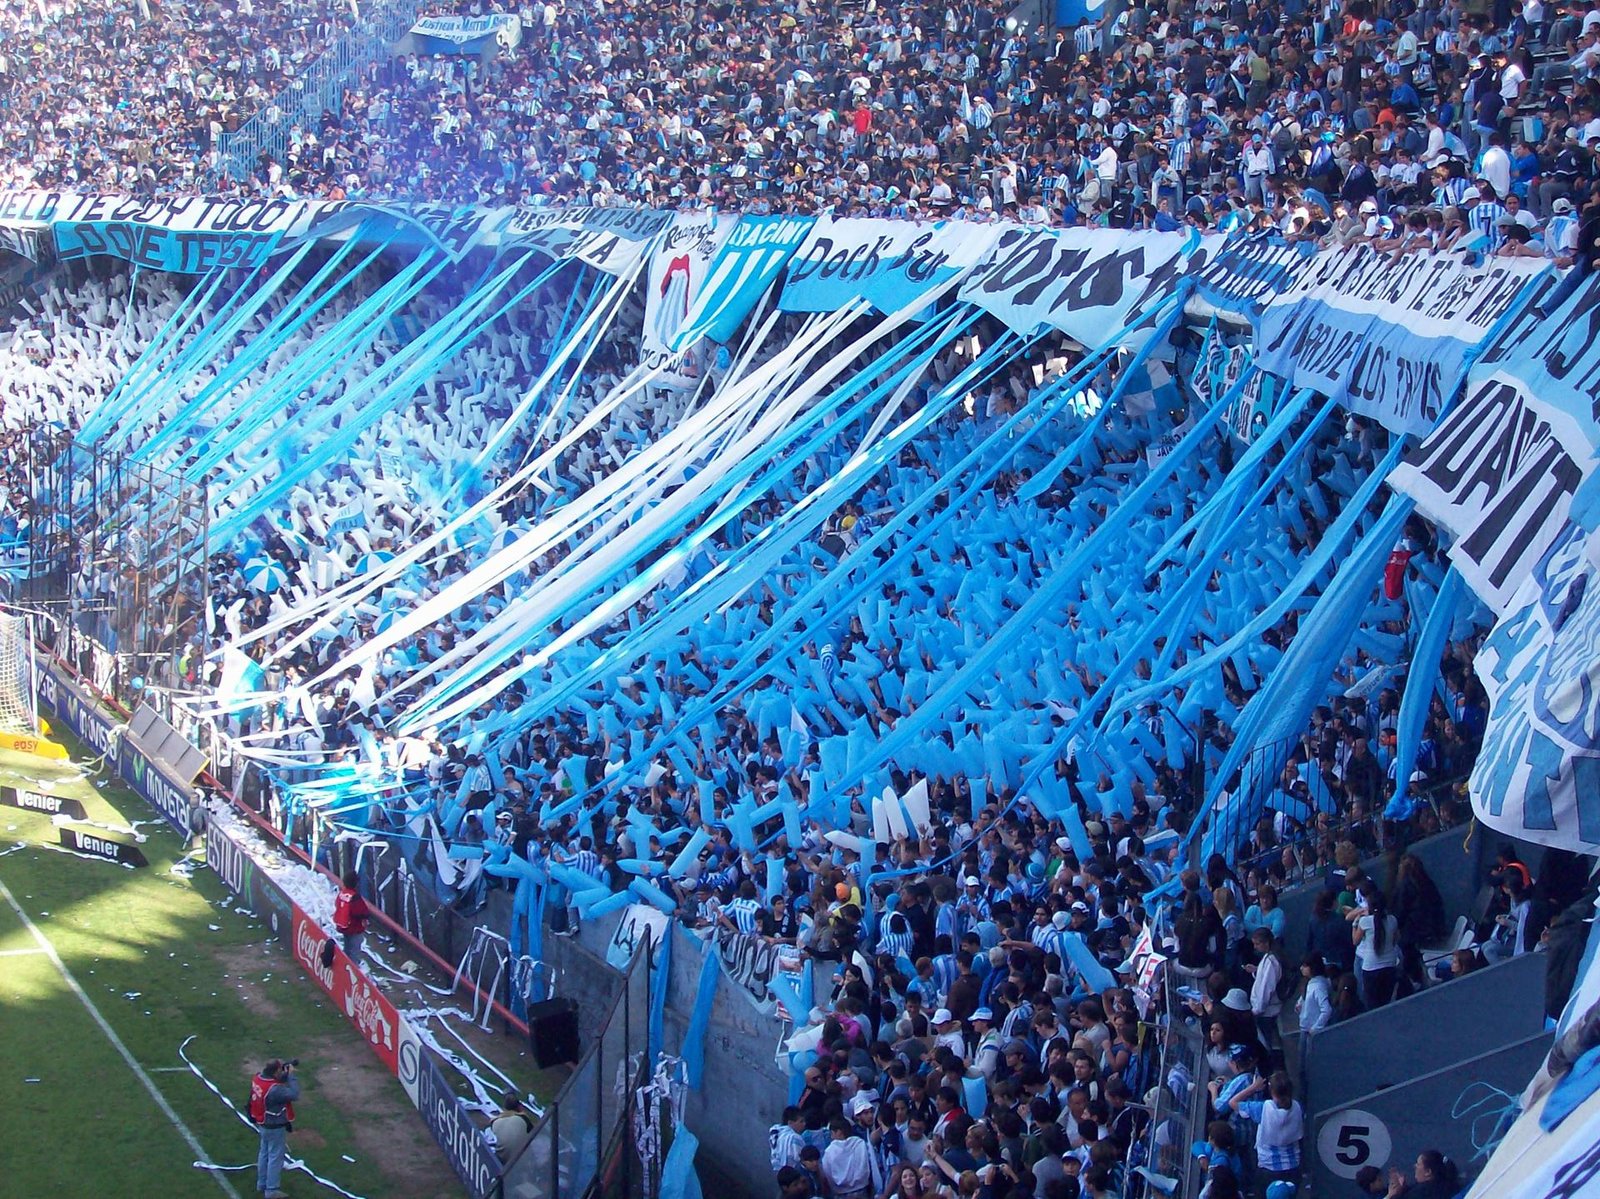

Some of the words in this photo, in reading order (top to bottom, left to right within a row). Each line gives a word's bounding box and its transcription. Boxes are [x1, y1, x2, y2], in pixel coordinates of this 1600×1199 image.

[16, 787, 62, 813] Venier
[75, 831, 120, 857] Venier
[207, 822, 242, 894] ESTILO
[1335, 1125, 1370, 1166] 5
